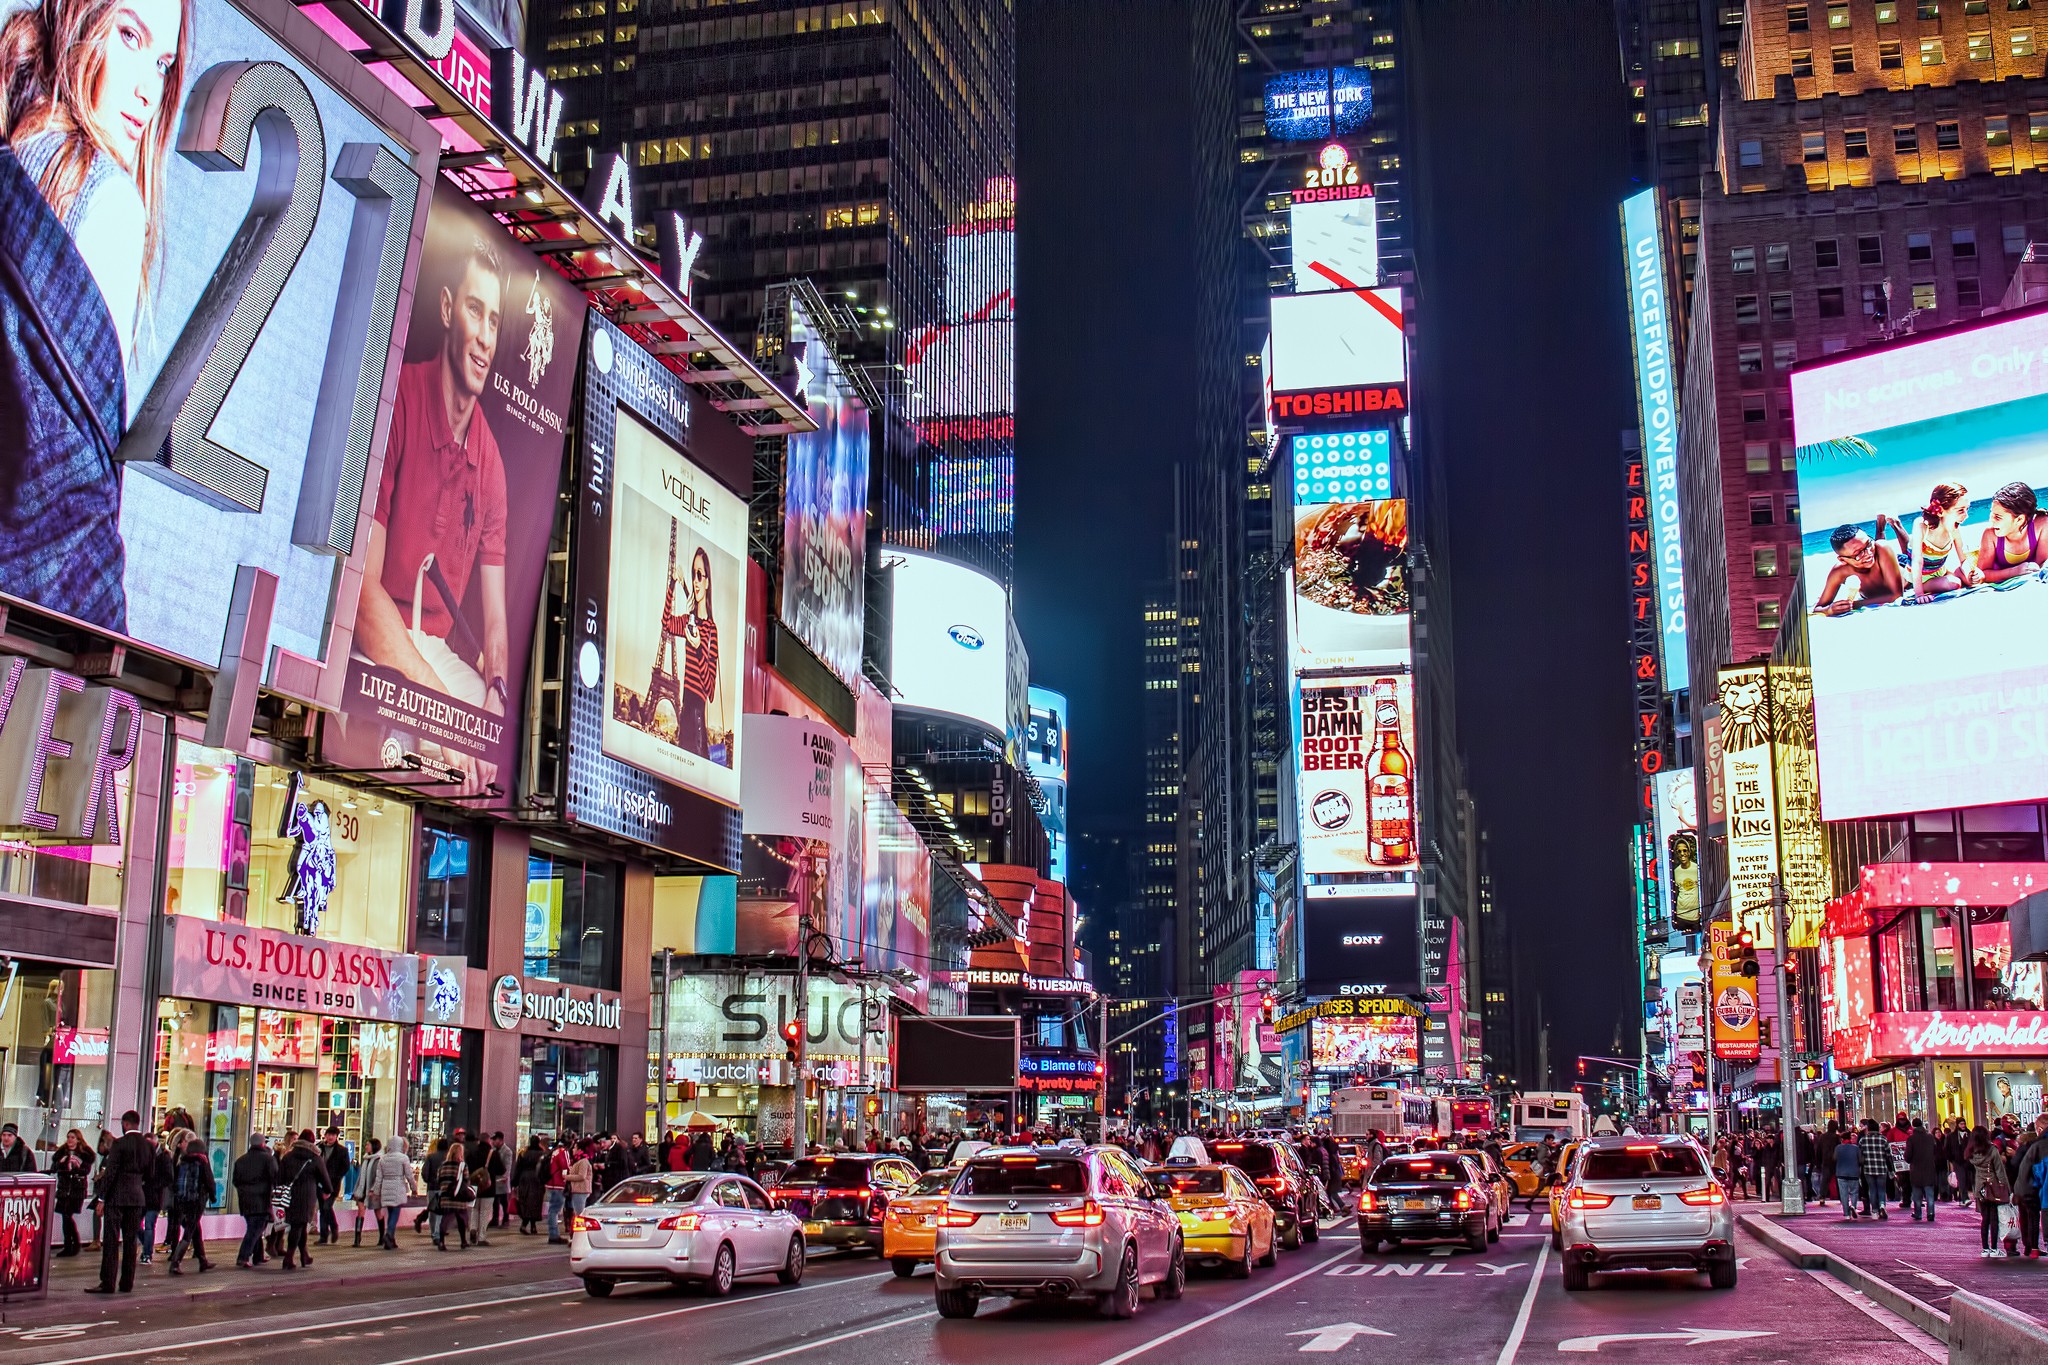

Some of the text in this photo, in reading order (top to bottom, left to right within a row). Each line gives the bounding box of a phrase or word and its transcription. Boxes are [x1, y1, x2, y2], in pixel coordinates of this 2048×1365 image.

[1272, 87, 1364, 109] THE NEW YORK
[1292, 105, 1344, 119] TRADITIN
[1305, 166, 1359, 188] 2016
[1292, 184, 1373, 203] TOSHIBA
[115, 61, 421, 556] 21
[615, 352, 690, 428] sunglass hut
[1824, 346, 2034, 412] No scarves. Only
[494, 372, 563, 434] U.S. POLO ASSN.
[1274, 388, 1405, 417] TOSHIBA
[506, 404, 545, 435] SINCE 1890
[809, 502, 852, 591] SAVIOR
[804, 543, 814, 581] IS
[1638, 655, 1656, 679] &
[360, 672, 503, 744] LIVE AUTHENTICALLY
[1303, 689, 1361, 713] BEST
[377, 706, 397, 721] JONNY
[398, 712, 417, 728] LAVINE
[421, 721, 428, 731] 17
[429, 723, 443, 736] YEAR
[443, 730, 454, 741] OLD
[454, 733, 468, 746] POLO
[468, 738, 486, 752] PLAYER
[1303, 712, 1363, 738] DAMN
[1304, 737, 1363, 753] ROOT
[1304, 753, 1364, 771] BEER
[991, 764, 1004, 827] 1500
[1735, 780, 1759, 792] THE
[600, 779, 672, 828] unglass hut
[1732, 795, 1765, 814] LION
[336, 812, 359, 842] $30
[1732, 817, 1771, 839] KING
[1737, 855, 1769, 863] TICKETS
[1343, 935, 1383, 945] SONY
[205, 929, 397, 991] U.S. POLO ASSN.
[967, 971, 991, 983] THE
[992, 971, 1020, 984] BOAT
[1038, 980, 1083, 993] TUESDAY
[253, 982, 355, 1009] SINCE 1890
[1339, 984, 1387, 995] SONY
[525, 988, 621, 1032] sunglass hut
[1717, 1006, 1755, 1016] BUBBA GUMP
[694, 1063, 756, 1080] swatch
[1041, 1060, 1076, 1071] Blame
[1078, 1060, 1088, 1071] for
[760, 1171, 779, 1184] JERSEY
[1324, 1263, 1529, 1276] ONLY
